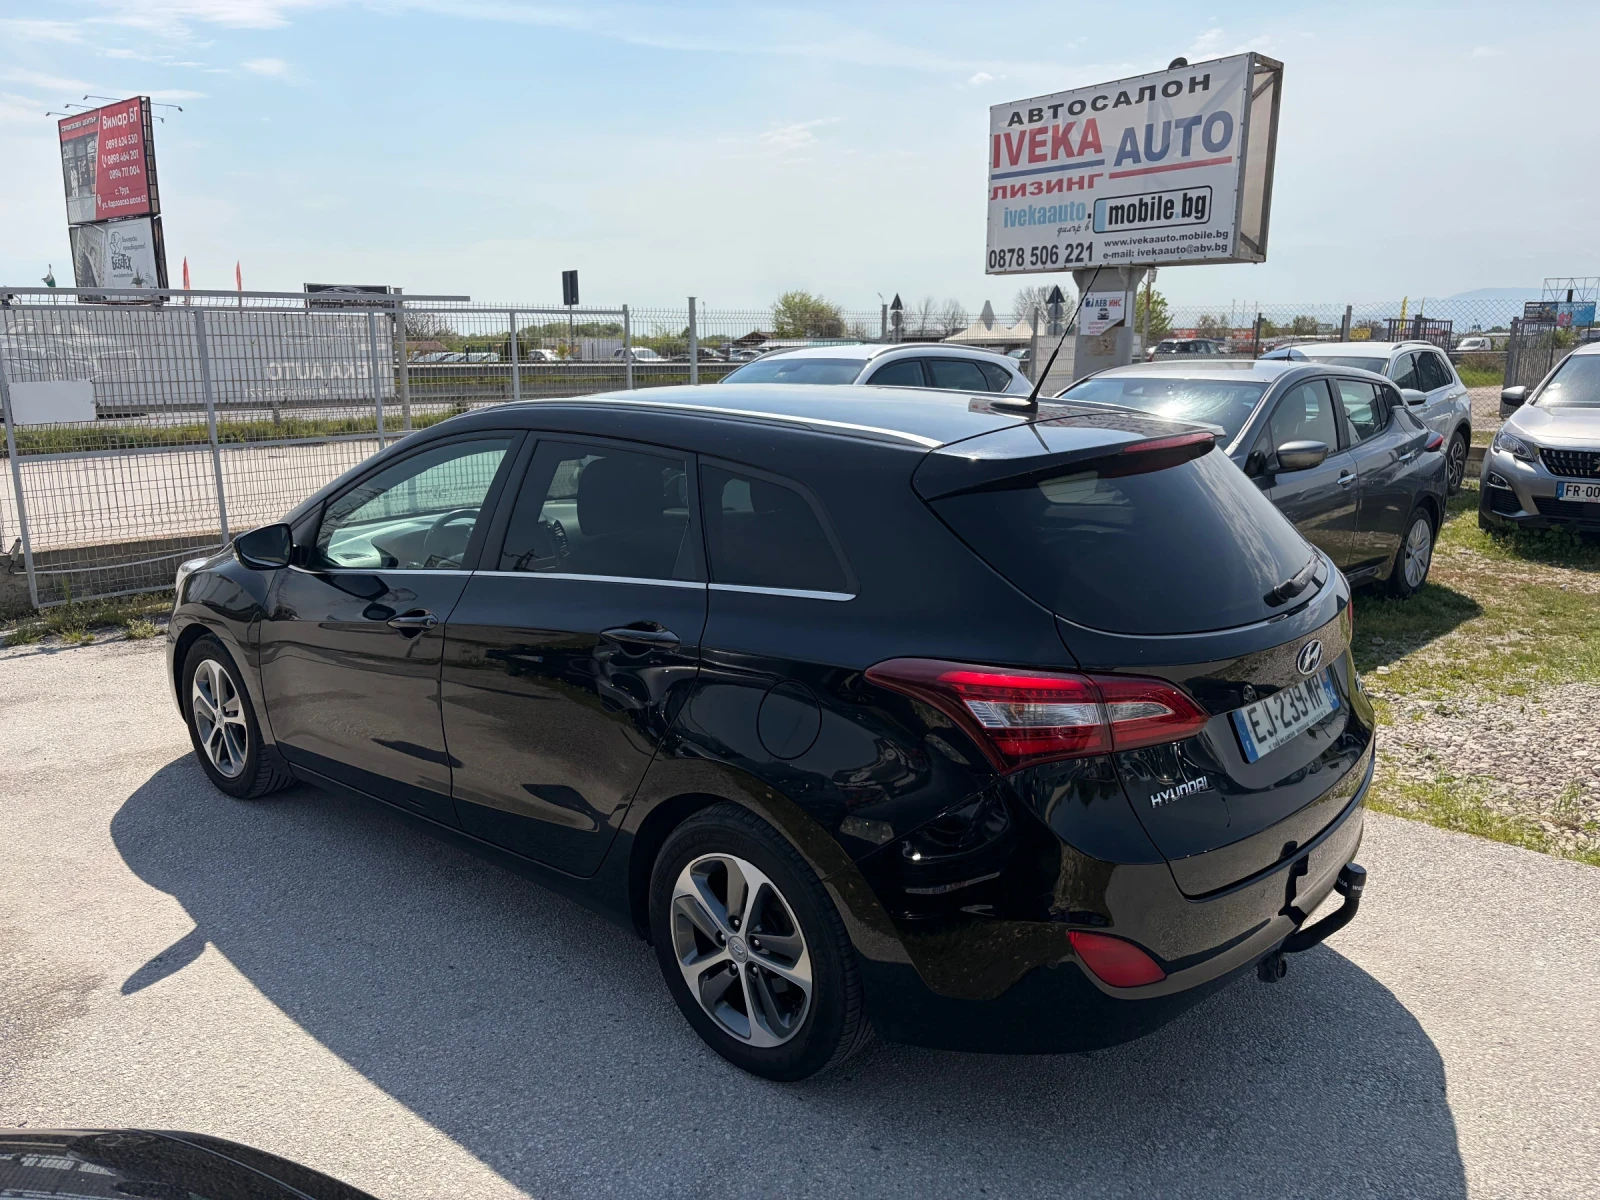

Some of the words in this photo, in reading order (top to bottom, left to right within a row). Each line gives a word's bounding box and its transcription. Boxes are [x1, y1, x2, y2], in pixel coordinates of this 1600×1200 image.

[1007, 73, 1211, 127] АВТОСАЛОН
[102, 113, 128, 130] Вимар
[129, 107, 138, 122] БГ
[993, 118, 1103, 169] IVEKA
[1113, 110, 1234, 167] AUTO
[990, 173, 1103, 201] ЛИЗИНГ
[1108, 192, 1206, 226] mobile.bg
[1103, 249, 1135, 259] e-mail:
[1137, 243, 1228, 257] ivekaauto@abv.bg
[1104, 230, 1229, 247] www.ivekaauto.mobile.bg
[989, 248, 1025, 269] 0878
[1030, 244, 1059, 266] 506
[1064, 242, 1093, 264] 221
[1150, 775, 1208, 808] HYUNDAI
